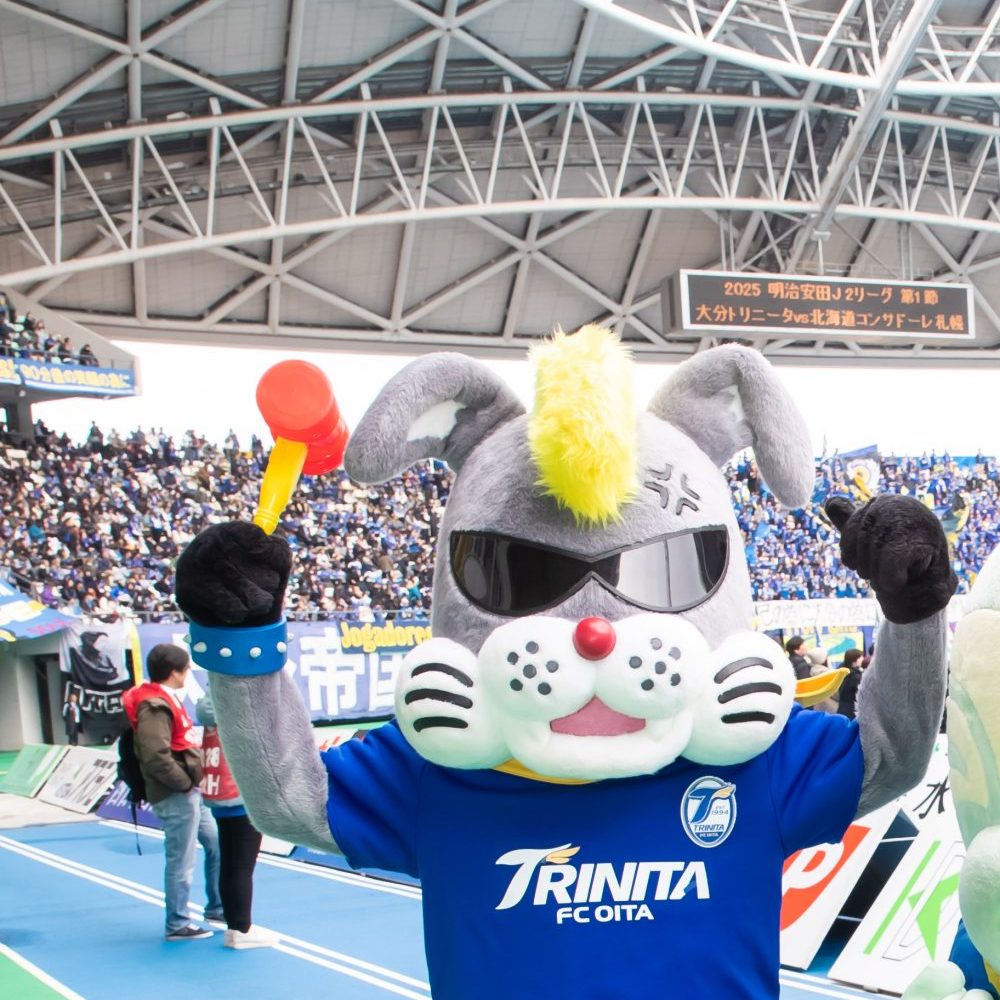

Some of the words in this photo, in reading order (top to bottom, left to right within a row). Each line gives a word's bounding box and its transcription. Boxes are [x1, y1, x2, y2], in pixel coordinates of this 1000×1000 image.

[724, 281, 761, 296] 2025
[767, 282, 893, 304] 明治安田J2リーグ
[694, 824, 724, 832] TRINITA
[495, 843, 711, 910] TRINITA
[556, 906, 590, 924] FC
[594, 904, 655, 923] OITA
